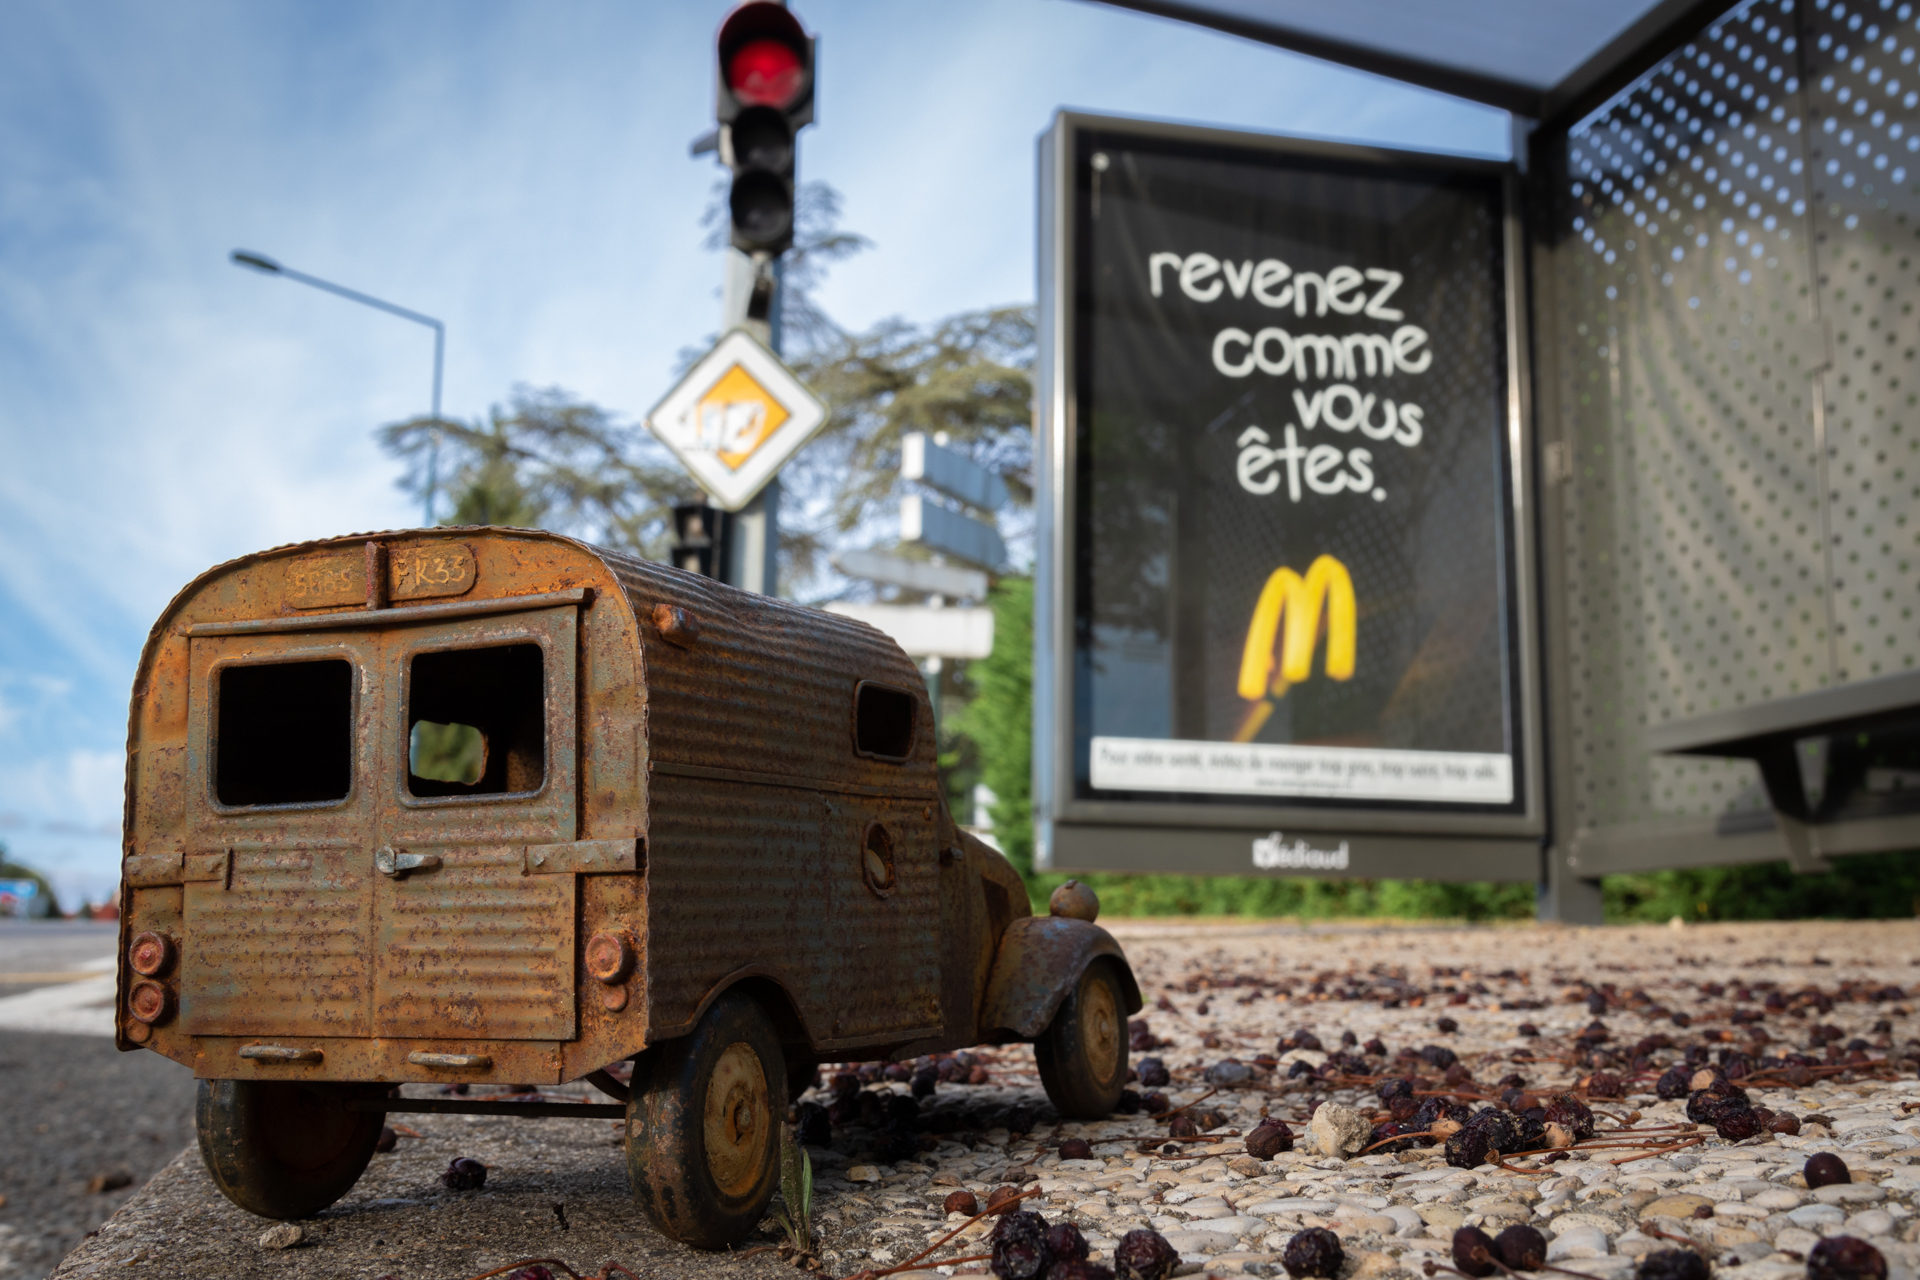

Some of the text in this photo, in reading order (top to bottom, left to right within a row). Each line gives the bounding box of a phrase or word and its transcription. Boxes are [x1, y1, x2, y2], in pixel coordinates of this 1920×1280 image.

[1150, 252, 1404, 322] revenez
[1212, 325, 1432, 382] comme
[1292, 384, 1424, 447] vous
[1236, 424, 1387, 503] êtes.
